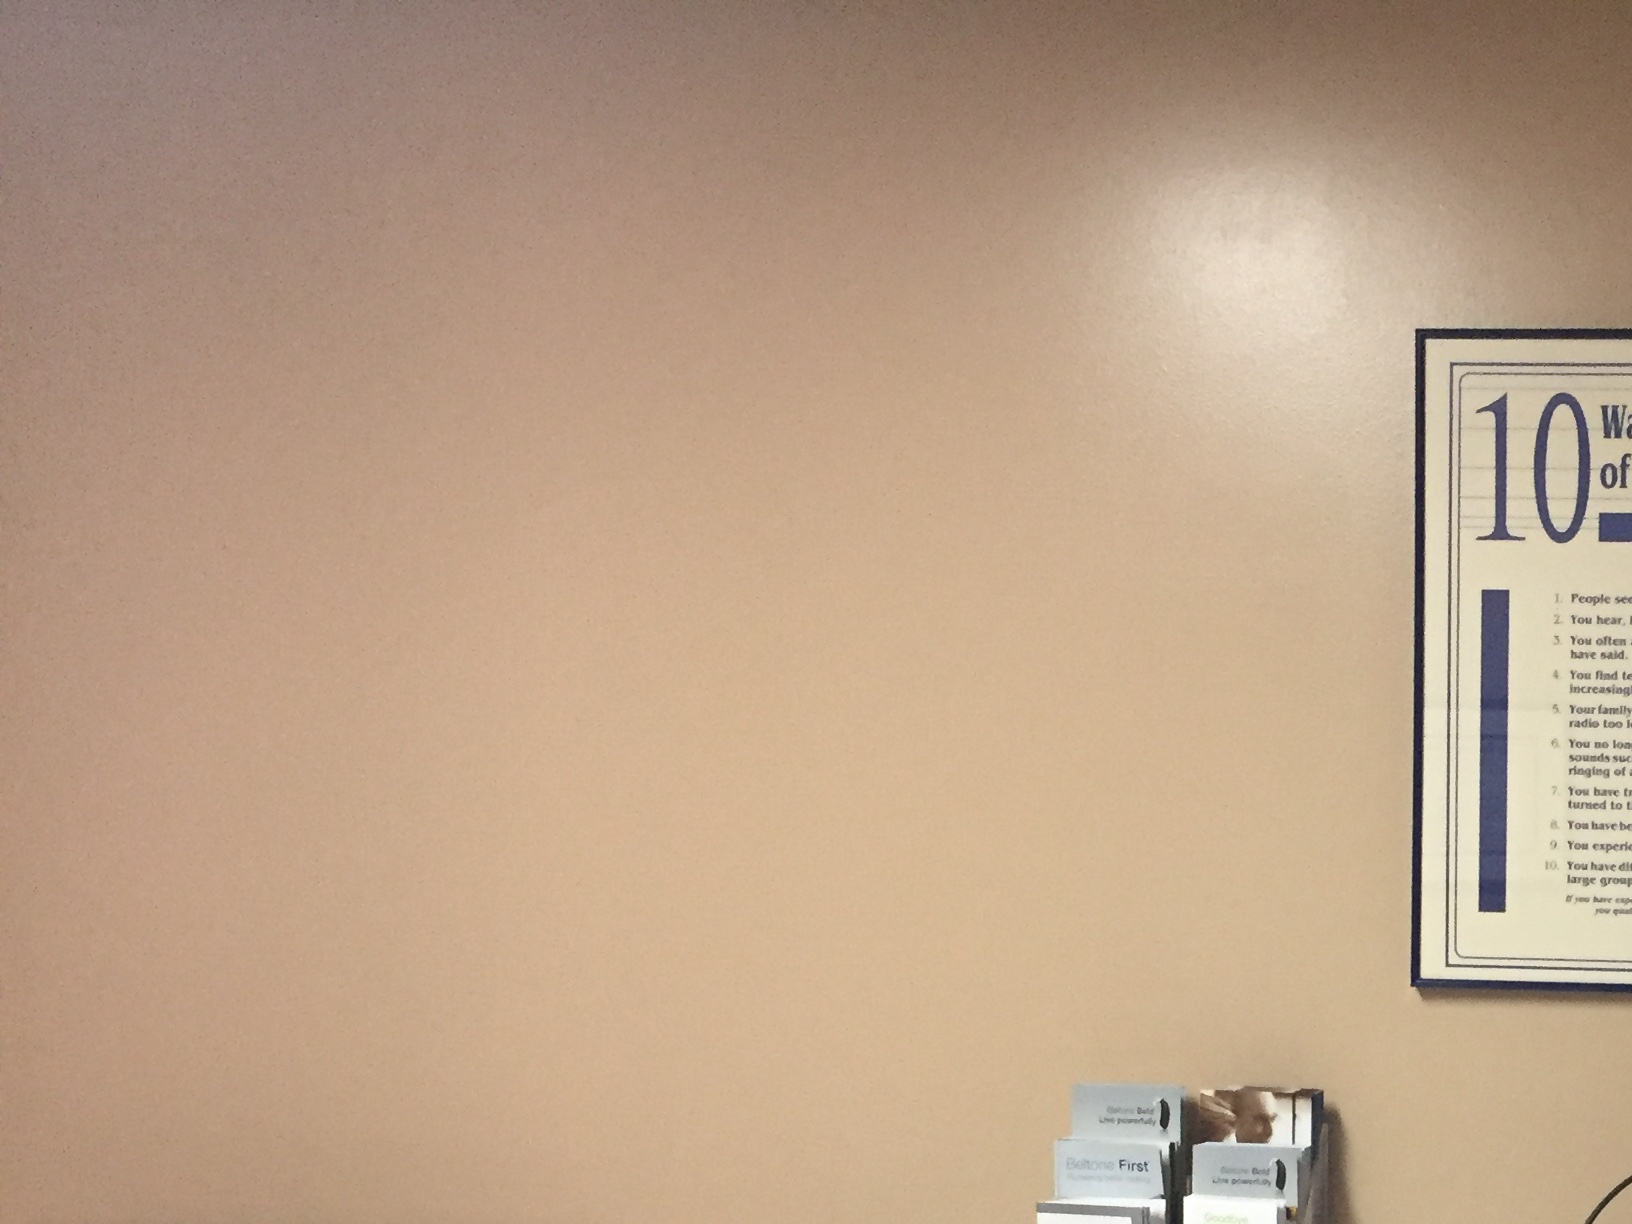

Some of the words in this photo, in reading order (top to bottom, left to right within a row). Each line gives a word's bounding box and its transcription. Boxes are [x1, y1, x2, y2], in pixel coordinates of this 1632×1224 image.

[1475, 392, 1592, 544] 10
[1600, 454, 1632, 490] of
[1571, 593, 1612, 606] People
[1571, 614, 1592, 624] You
[1597, 615, 1626, 626] hear,
[1570, 635, 1592, 646] You
[1596, 636, 1626, 646] often
[1570, 650, 1596, 660] have
[1600, 650, 1628, 660] said.
[1570, 670, 1592, 680] You
[1595, 670, 1618, 680] find
[1569, 704, 1596, 714] Your
[1597, 704, 1632, 718] family
[1569, 718, 1600, 728] radio
[1603, 719, 1622, 728] too
[1569, 738, 1590, 748] You
[1594, 741, 1610, 750] no
[1568, 753, 1610, 762] sounds
[1568, 766, 1610, 778] ringing
[1614, 766, 1626, 776] of
[1568, 786, 1590, 796] You
[1593, 787, 1620, 796] have
[1568, 800, 1606, 810] turned
[1610, 801, 1622, 810] to
[1567, 820, 1588, 830] You
[1591, 821, 1618, 830] have
[1567, 840, 1588, 850] You
[1567, 861, 1588, 870] You
[1591, 861, 1616, 872] have
[1567, 874, 1596, 886] large
[1118, 1159, 1150, 1172] First
